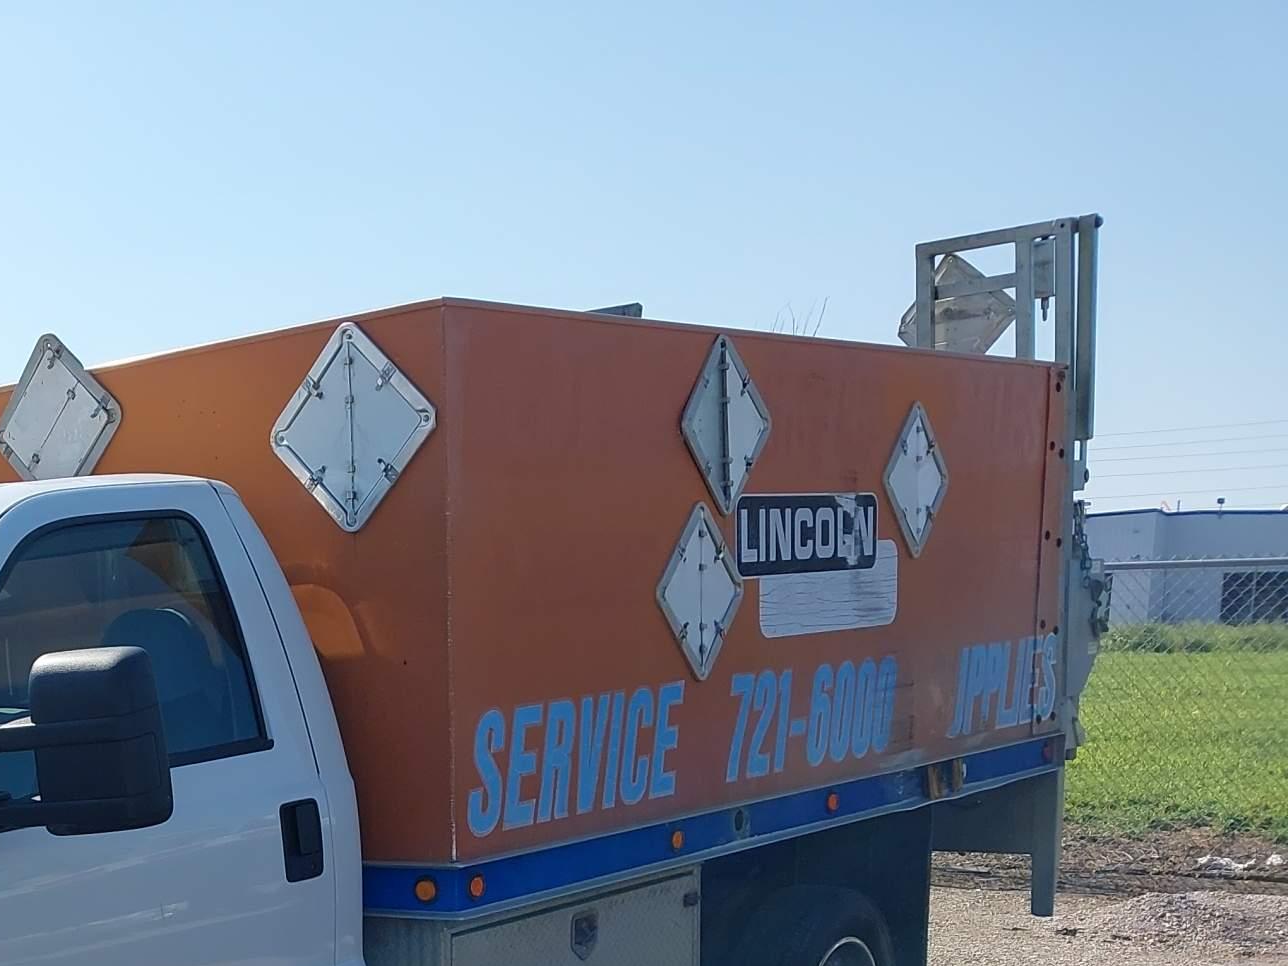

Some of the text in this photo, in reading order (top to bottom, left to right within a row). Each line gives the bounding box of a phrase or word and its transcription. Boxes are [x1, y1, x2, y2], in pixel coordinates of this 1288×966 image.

[740, 506, 874, 563] LINCOLN
[467, 680, 685, 838] SERVICE
[726, 656, 897, 783] 721-6000
